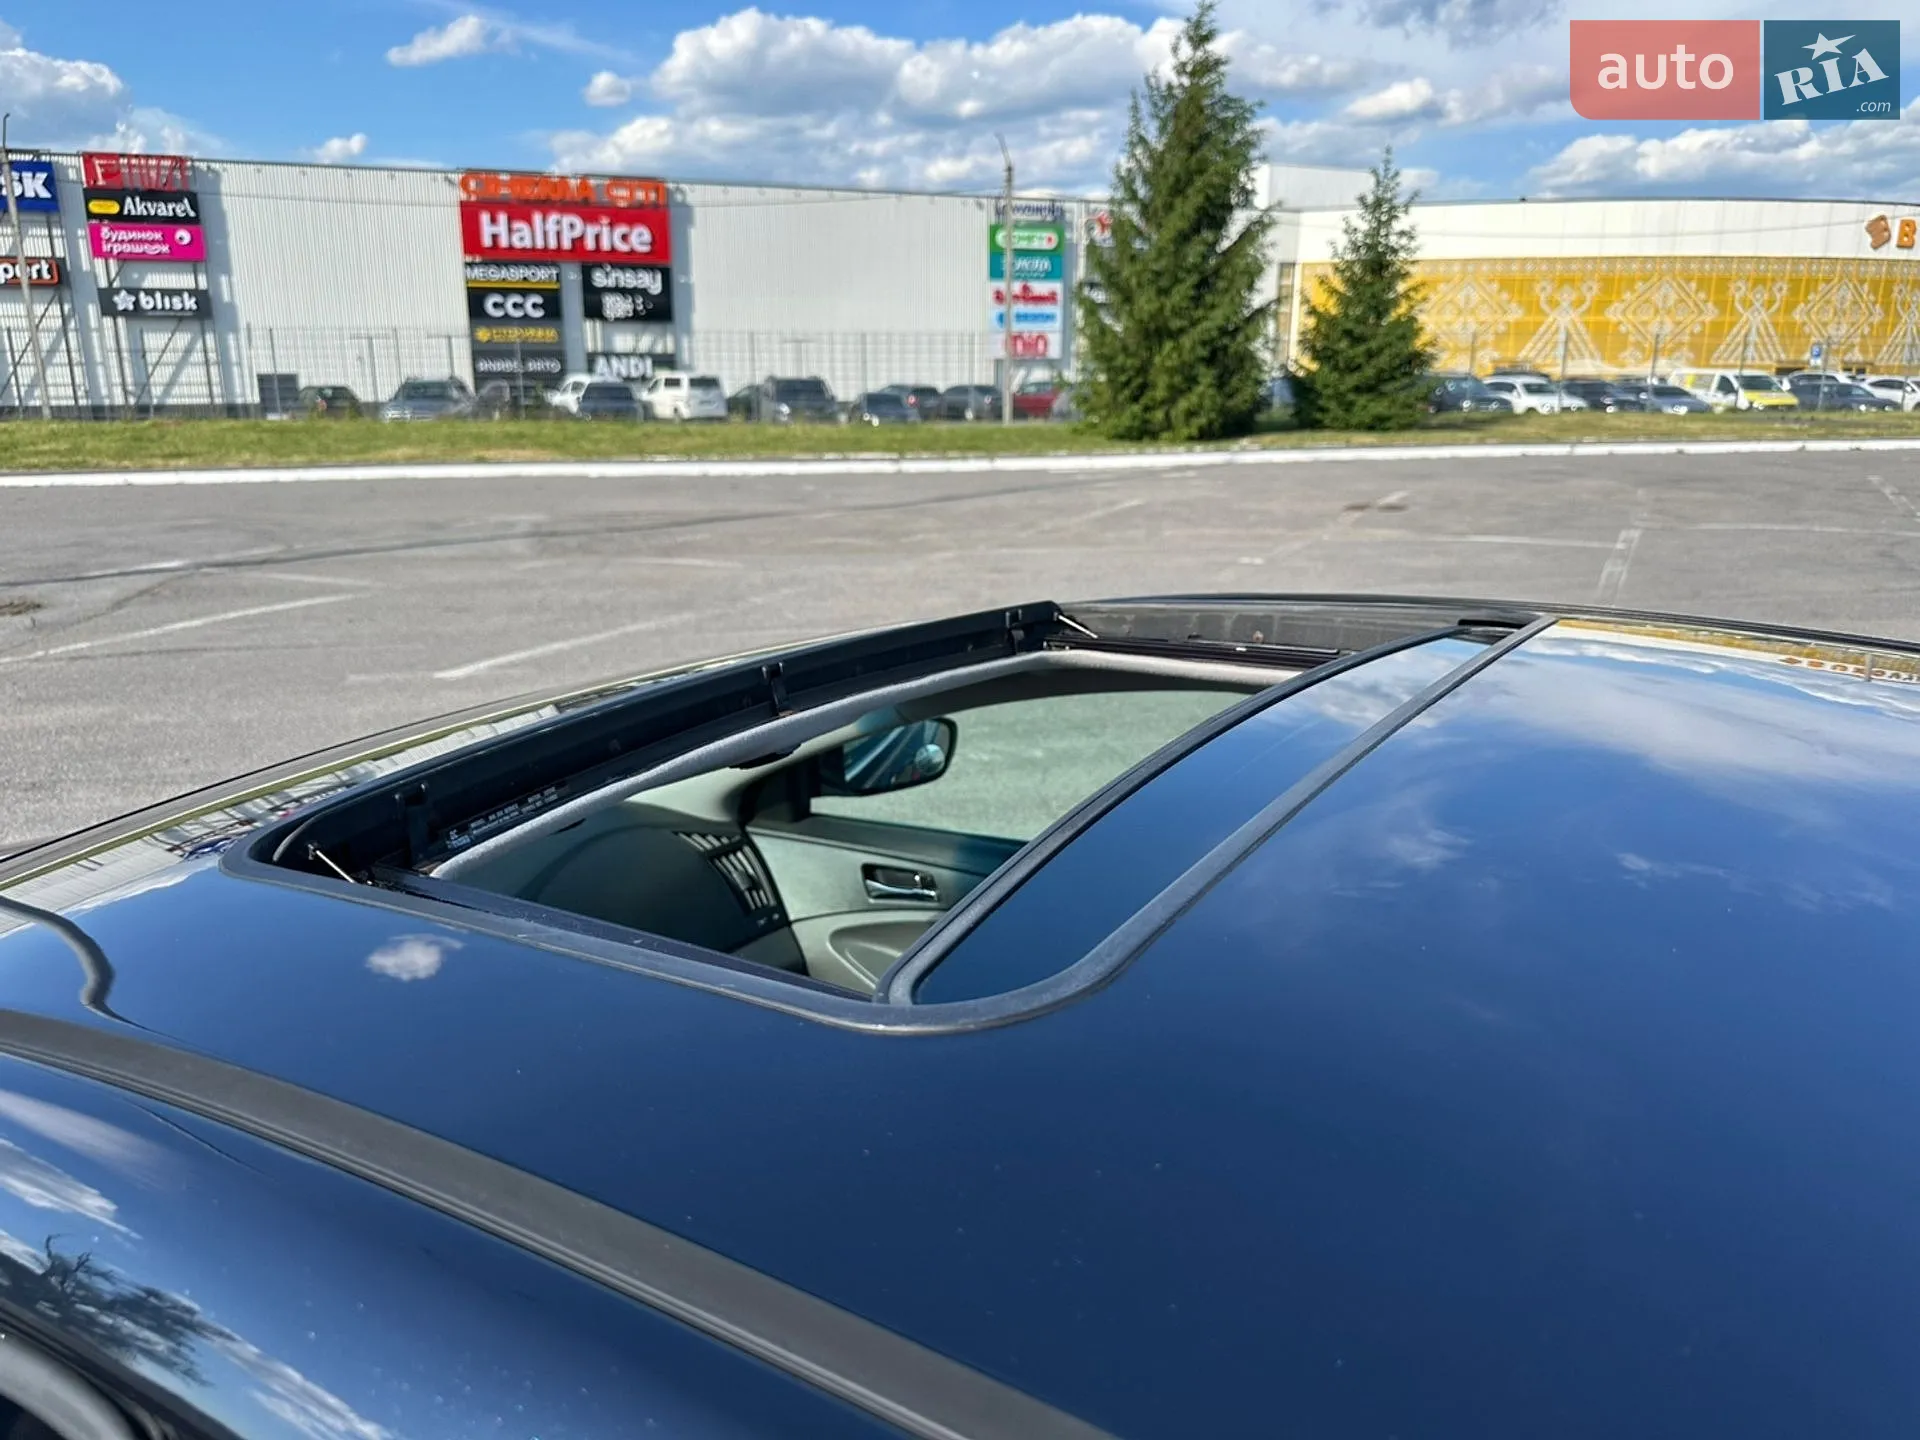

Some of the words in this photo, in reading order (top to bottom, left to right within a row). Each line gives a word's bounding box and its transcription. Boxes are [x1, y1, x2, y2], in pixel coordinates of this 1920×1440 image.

[123, 195, 197, 219] Akvarel
[478, 208, 654, 254] HalfPrice
[466, 264, 560, 282] MEGASPORT
[590, 264, 663, 296] sinsay
[139, 290, 199, 312] blisk
